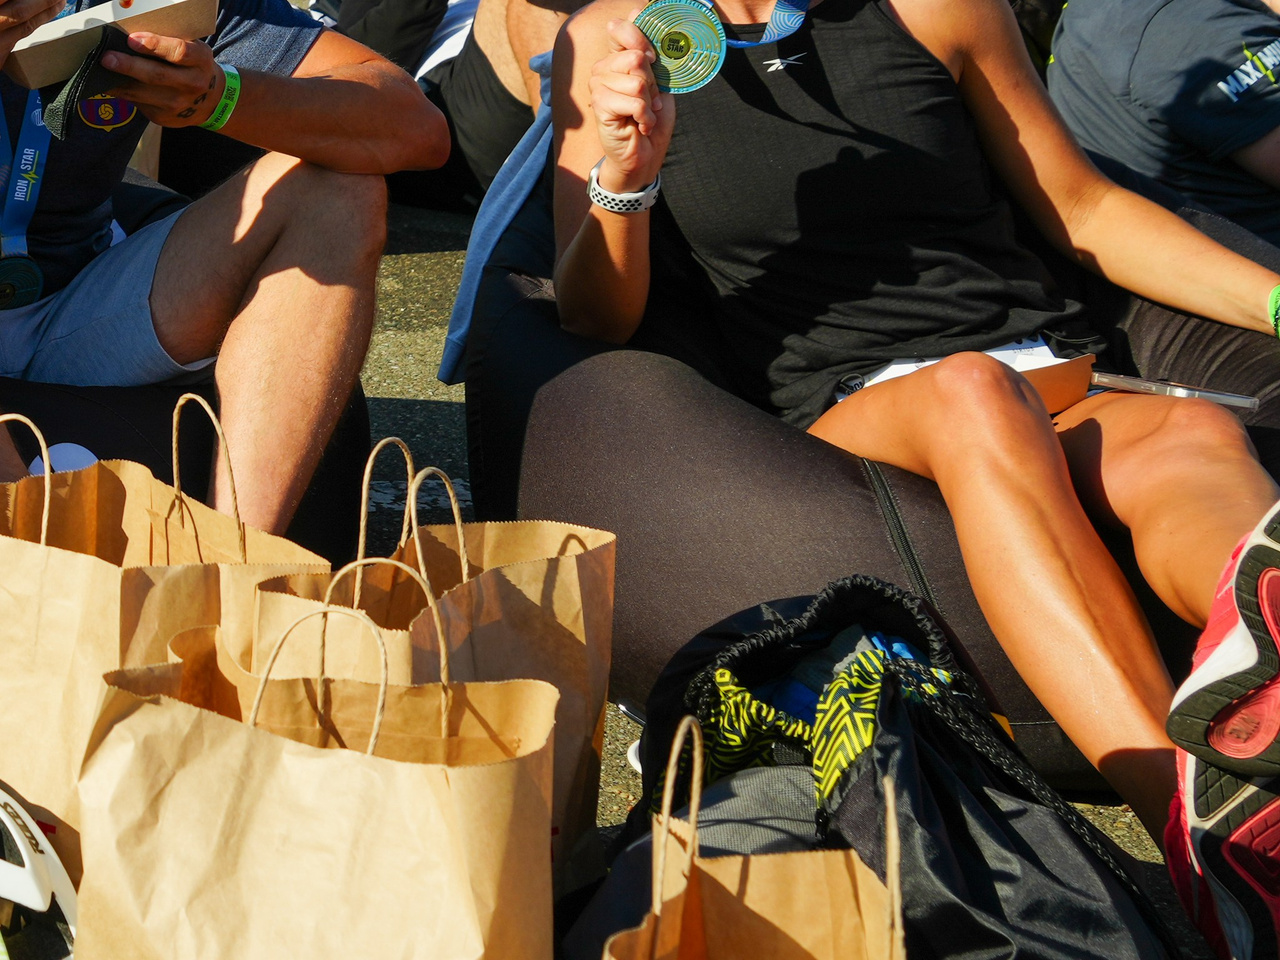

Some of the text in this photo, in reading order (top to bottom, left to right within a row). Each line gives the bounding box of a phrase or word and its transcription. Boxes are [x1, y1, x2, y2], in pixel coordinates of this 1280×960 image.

[1217, 60, 1265, 103] MAX
[20, 147, 36, 171] STAR
[14, 179, 29, 202] IRON
